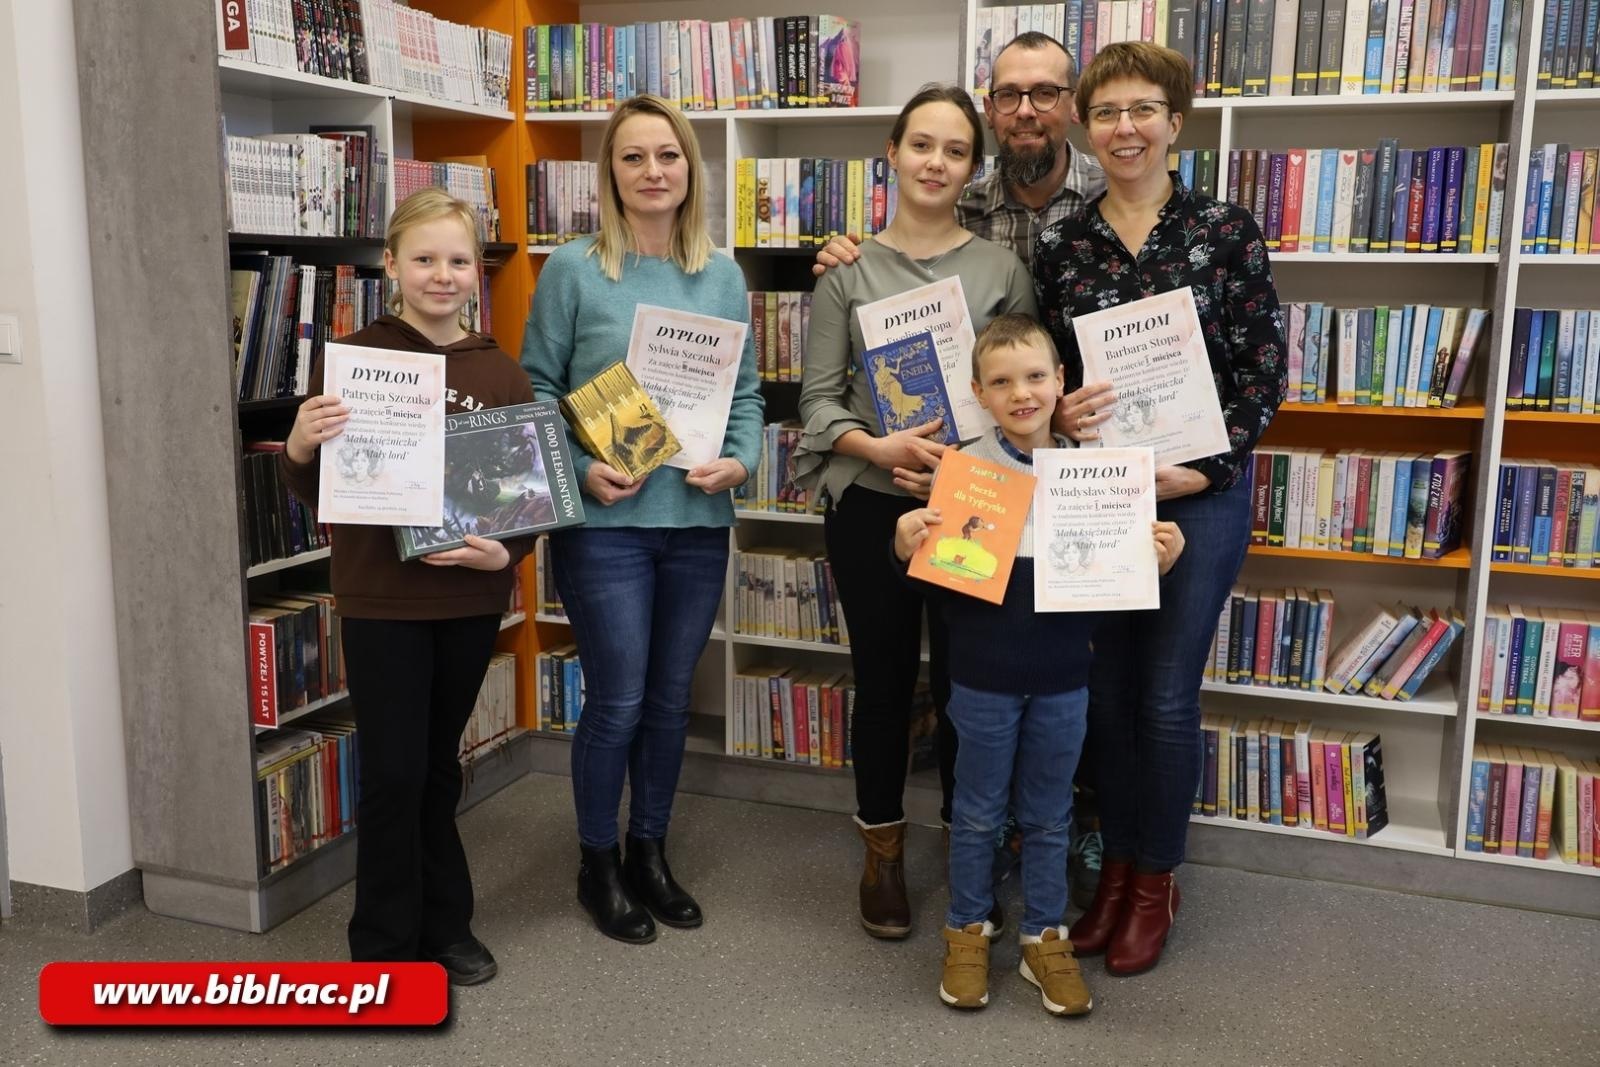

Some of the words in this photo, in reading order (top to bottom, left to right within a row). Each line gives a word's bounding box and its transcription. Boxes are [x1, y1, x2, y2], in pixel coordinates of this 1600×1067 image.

[1491, 24, 1499, 45] NEVER
[1426, 48, 1438, 78] HOOVER
[1439, 49, 1450, 78] HOOVER
[1488, 46, 1497, 66] NEVER
[1503, 46, 1513, 76] HOOVER
[1572, 161, 1580, 176] SHE
[1570, 178, 1578, 203] DRIVES
[884, 301, 943, 330] DYPLOM
[656, 325, 721, 348] DYPLOM
[1103, 313, 1171, 343] DYPLOM
[648, 343, 680, 358] Sylwia
[682, 350, 721, 366] Szczuka
[1104, 342, 1148, 361] Barbara
[1149, 333, 1181, 350] Stopa
[689, 367, 716, 378] miejsca
[900, 363, 935, 381] ENEIDA
[1108, 366, 1119, 376] Za
[1120, 359, 1145, 373] zajęcie
[1152, 350, 1183, 364] miejsca
[351, 367, 420, 386] DYPLOM
[341, 387, 386, 403] Patrycja
[388, 392, 431, 406] Szczuka
[1157, 389, 1179, 403] lord"
[359, 408, 385, 418] zajęcie
[393, 410, 422, 420] miejsca
[468, 411, 508, 428] RINGS
[369, 435, 422, 448] księżniczka"
[543, 422, 559, 448] 1000
[388, 450, 411, 461] lord"
[1058, 466, 1128, 480] DYPLOM
[550, 450, 576, 519] ELEMENTÓW
[1049, 486, 1107, 499] Władysław
[1109, 485, 1141, 497] Stopa
[953, 489, 967, 502] dla
[968, 495, 1007, 515] Tygryska
[1057, 503, 1067, 512] Za
[1067, 502, 1094, 513] zajęcie
[1101, 502, 1132, 511] miejsca
[1078, 526, 1132, 538] księżniczka"
[1098, 538, 1121, 550] lord"
[1571, 634, 1583, 659] AFTER
[258, 632, 269, 682] POWYŻEJ
[261, 684, 269, 697] 15
[262, 699, 270, 719] LAT
